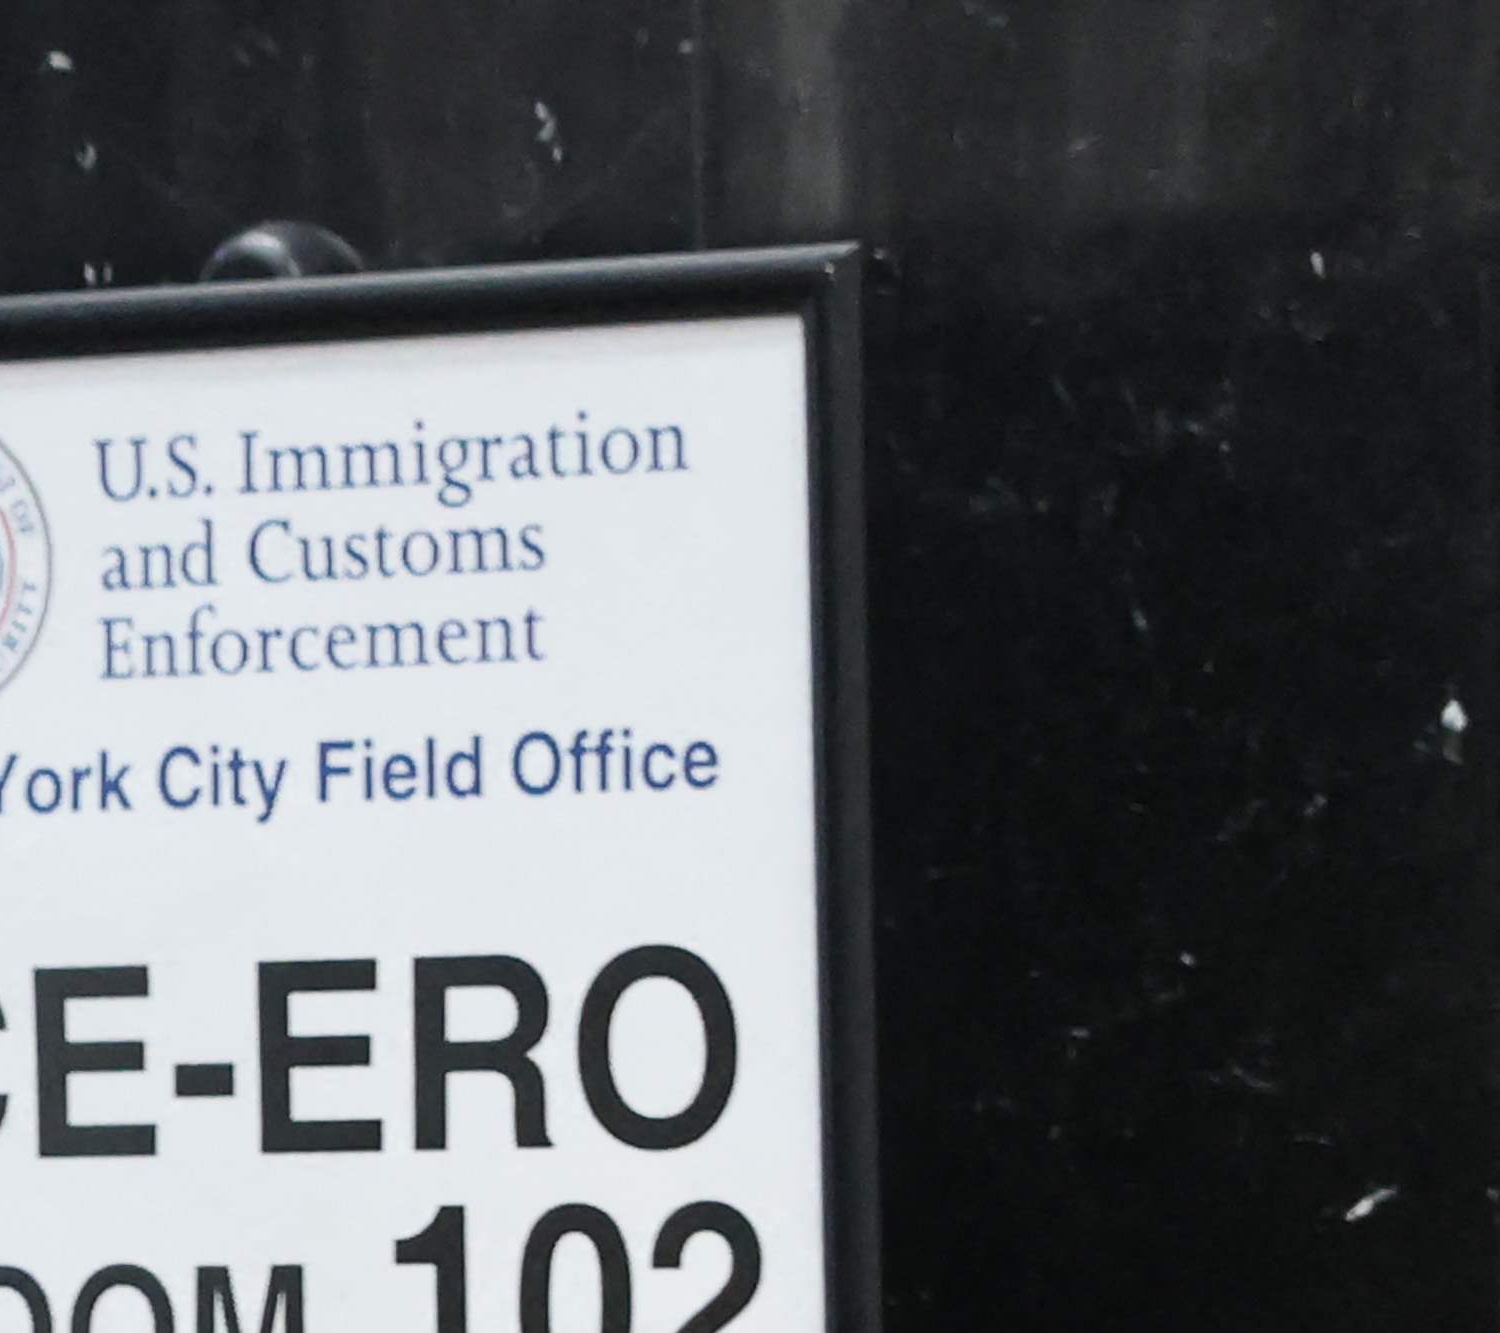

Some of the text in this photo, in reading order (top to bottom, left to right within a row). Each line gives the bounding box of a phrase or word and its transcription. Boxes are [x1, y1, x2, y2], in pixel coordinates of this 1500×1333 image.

[95, 410, 689, 508] U.S. Immigration
[101, 517, 546, 592] and Customs
[100, 603, 545, 680] Enforcement
[157, 744, 288, 825] City
[317, 734, 484, 804] Field
[511, 727, 719, 797] Office
